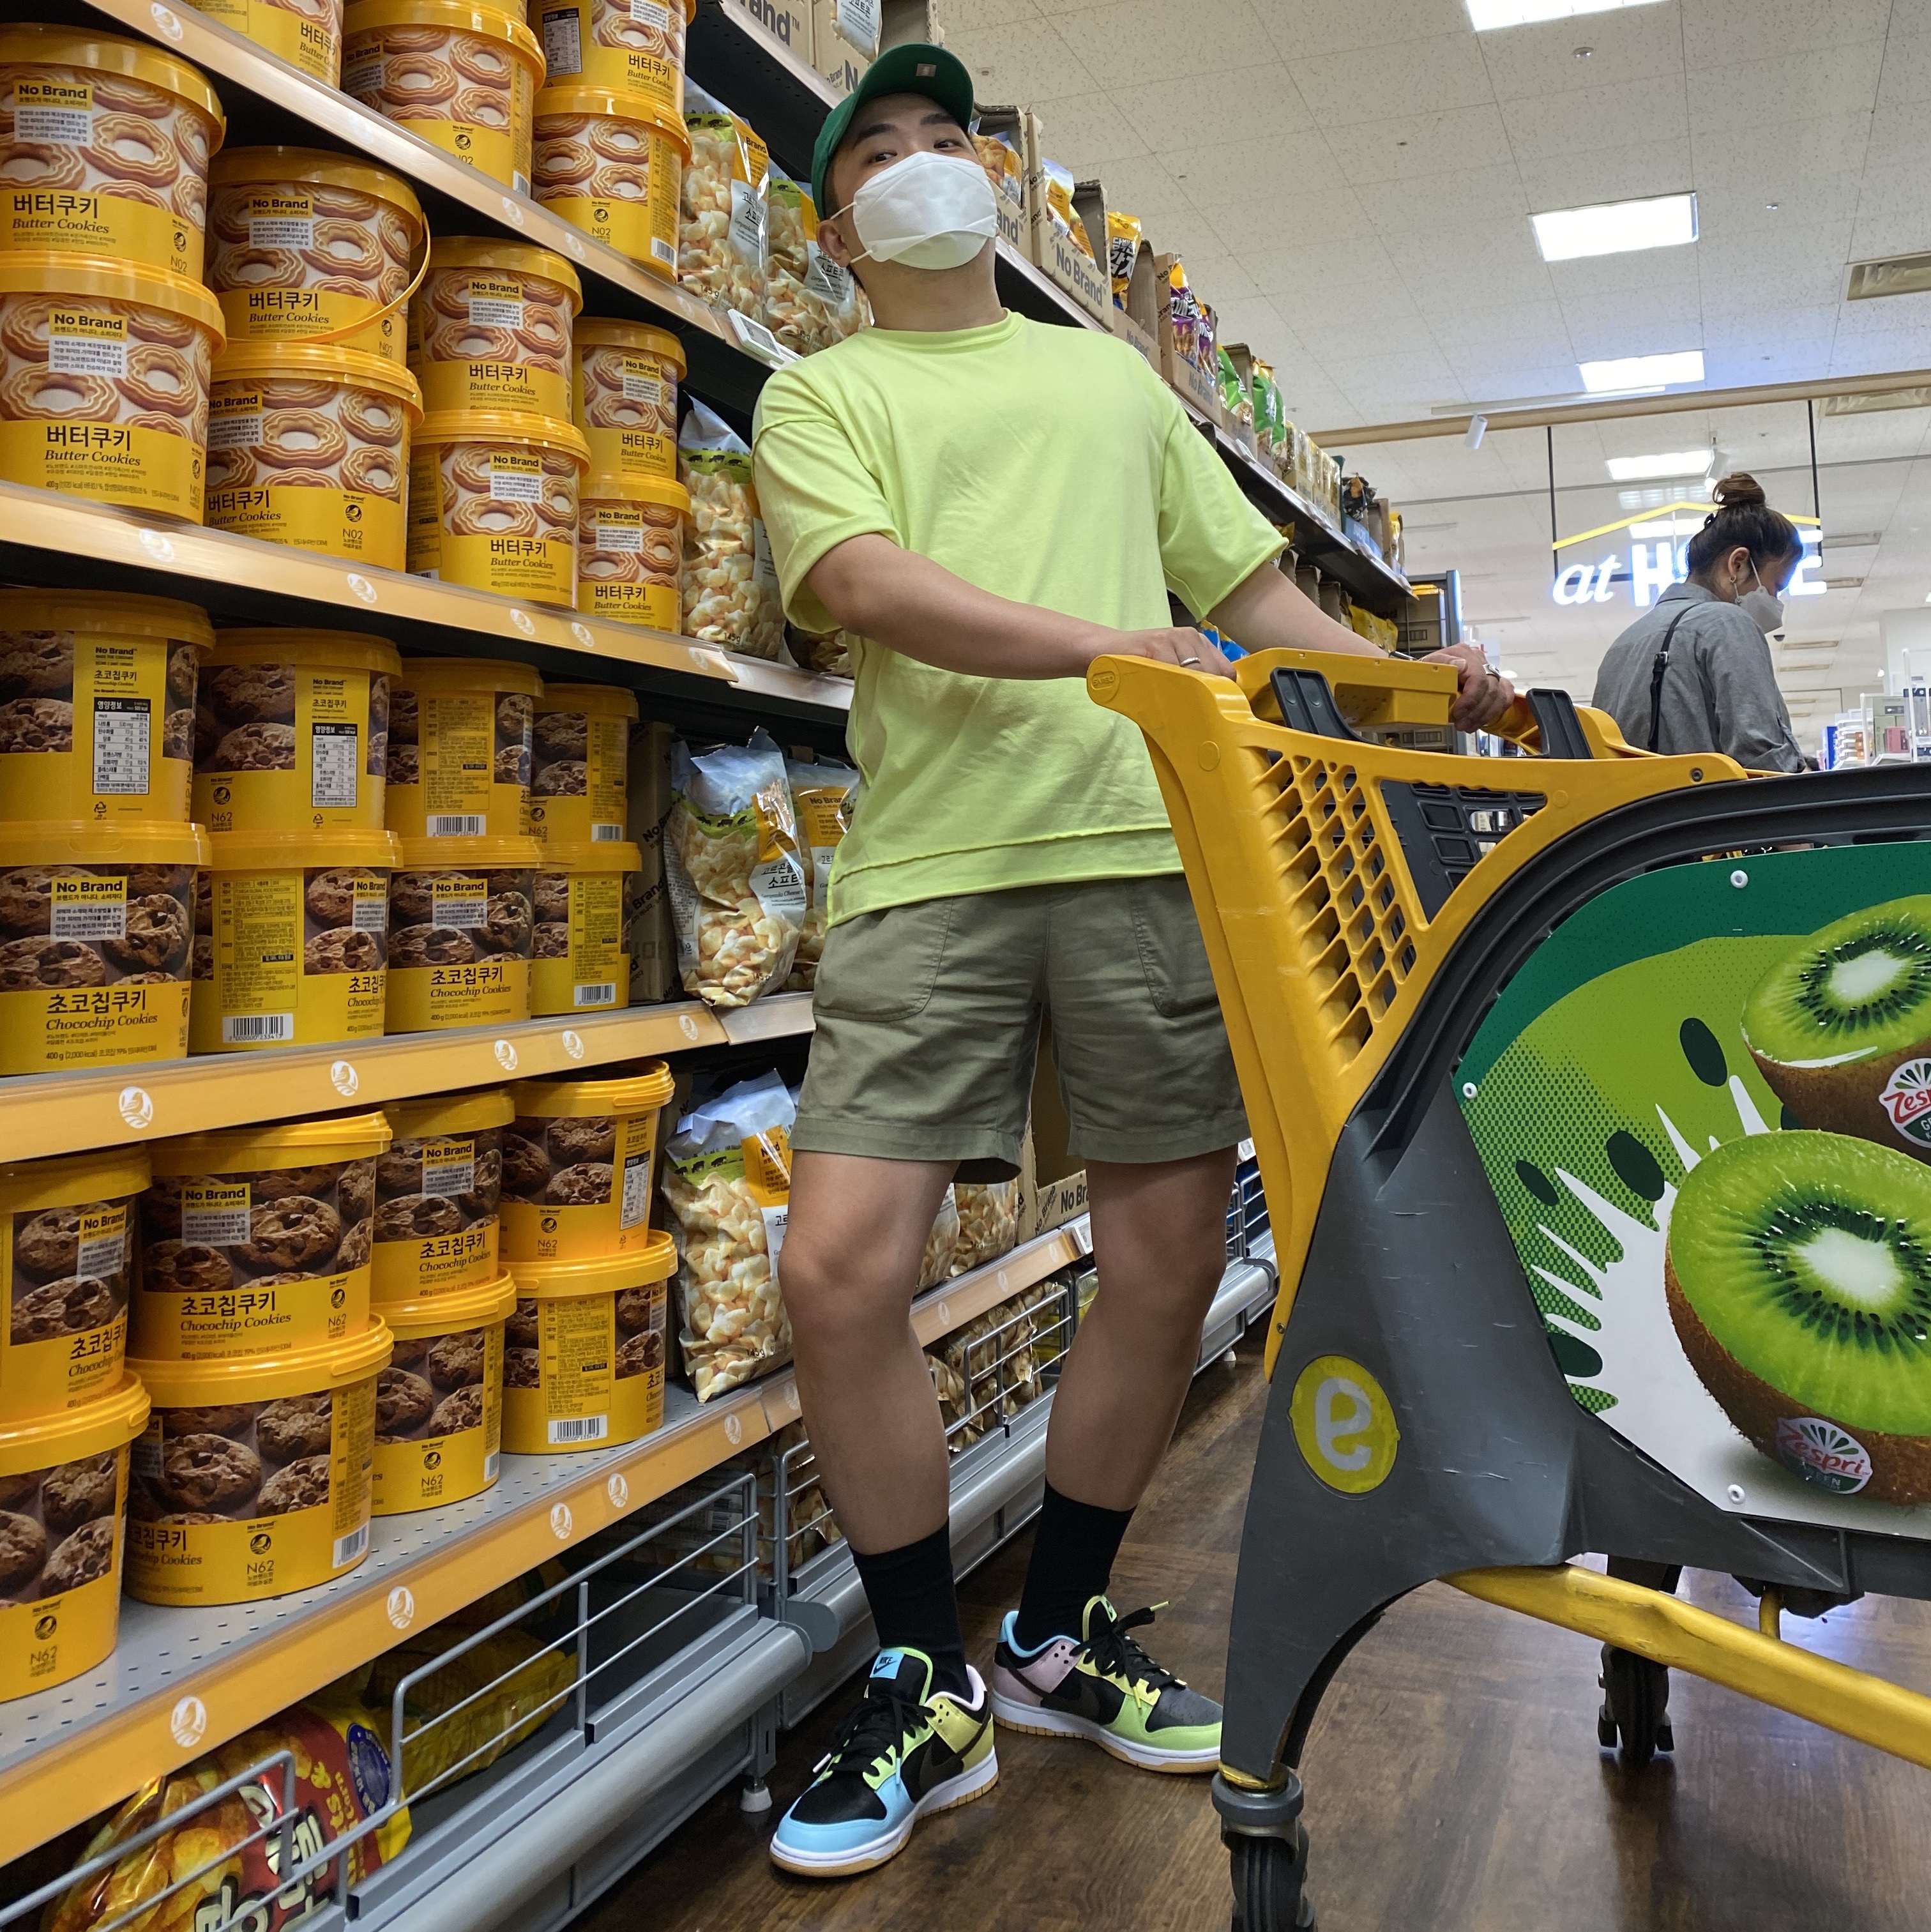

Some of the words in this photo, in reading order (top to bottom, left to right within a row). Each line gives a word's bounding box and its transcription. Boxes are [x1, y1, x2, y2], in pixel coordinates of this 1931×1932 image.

[299, 42, 324, 60] Butter
[356, 45, 380, 59] Brand
[629, 54, 670, 80] 버터쿠키
[628, 69, 651, 81] Butter
[19, 84, 39, 95] No
[42, 86, 87, 99] Brand
[13, 194, 98, 219] 버터쿠키
[253, 199, 269, 208] No
[272, 199, 308, 209] Brand
[12, 218, 55, 229] Butter
[57, 218, 109, 234] Cookies
[592, 227, 611, 236] N02
[170, 255, 187, 273] N02
[1056, 243, 1072, 277] No
[1073, 259, 1103, 308] Brand
[1156, 269, 1169, 282] No
[472, 282, 487, 290] No
[489, 283, 519, 294] Brand
[249, 291, 318, 311] 버터쿠키
[54, 314, 75, 325] No
[79, 315, 122, 330] Brand
[249, 313, 284, 323] Butter
[286, 312, 329, 324] Cookies
[469, 364, 527, 384] 버터쿠키
[626, 360, 637, 369] No
[639, 362, 659, 374] Brand
[469, 383, 501, 391] Butter
[502, 383, 536, 395] Cookies
[209, 400, 222, 409] No
[224, 395, 258, 407] Brand
[47, 425, 131, 452] 버터쿠키
[622, 433, 663, 453] 버터쿠키
[45, 450, 89, 461] Butter
[91, 452, 141, 466] Cookies
[494, 455, 508, 464] No
[510, 457, 539, 468] Brand
[621, 448, 644, 458] Butter
[645, 451, 667, 463] Cookies
[208, 489, 269, 513] 버터쿠키
[209, 514, 237, 526] Butter
[239, 510, 282, 522] Cookies
[614, 512, 640, 521] Brand
[342, 528, 363, 539] N02
[490, 538, 547, 558] 버터쿠키
[490, 558, 521, 567] Butter
[523, 558, 554, 570] Cookies
[1554, 554, 1621, 605] at
[1632, 529, 1827, 606] HE
[595, 586, 646, 601] 버터쿠키
[623, 602, 652, 611] Cookies
[723, 632, 736, 641] 145
[736, 636, 741, 644] g
[95, 670, 137, 681] 초코칩쿠키
[97, 701, 123, 710] 영양정보
[312, 699, 347, 708] 초코칩쿠키
[315, 726, 335, 734] 영양정보
[211, 812, 232, 822] N62
[529, 826, 548, 835] N62
[57, 882, 77, 893] No
[80, 880, 123, 892] Brand
[356, 881, 368, 890] No
[454, 882, 484, 892] Brand
[431, 966, 503, 985] 초코칩쿠키
[430, 987, 481, 998] Chocochip
[482, 984, 511, 994] Cookies
[47, 989, 146, 1014] 초코칩쿠키
[46, 1016, 115, 1030] Chocochip
[117, 1013, 158, 1026] Cookies
[426, 1148, 441, 1158] No
[444, 1143, 473, 1157] Brand
[185, 1190, 203, 1201] No
[206, 1187, 246, 1200] Brand
[1061, 1190, 1075, 1214] No
[84, 1218, 99, 1230] No
[101, 1210, 125, 1227] Brand
[420, 1231, 486, 1259] 초코칩쿠키
[537, 1239, 557, 1248] N62
[420, 1256, 467, 1272] Chocochip
[469, 1250, 491, 1264] Cookies
[181, 1291, 275, 1317] 초코칩쿠키
[181, 1319, 241, 1332] Chocochip
[244, 1313, 292, 1328] Cookies
[328, 1314, 347, 1328] N62
[68, 1353, 114, 1378] Chocochip
[1315, 1376, 1372, 1471] e
[1778, 1420, 1865, 1475] Zespri
[421, 1474, 443, 1487] N62
[161, 1554, 203, 1565] Cookies
[246, 1560, 274, 1575] N62
[30, 1645, 57, 1666] N62
